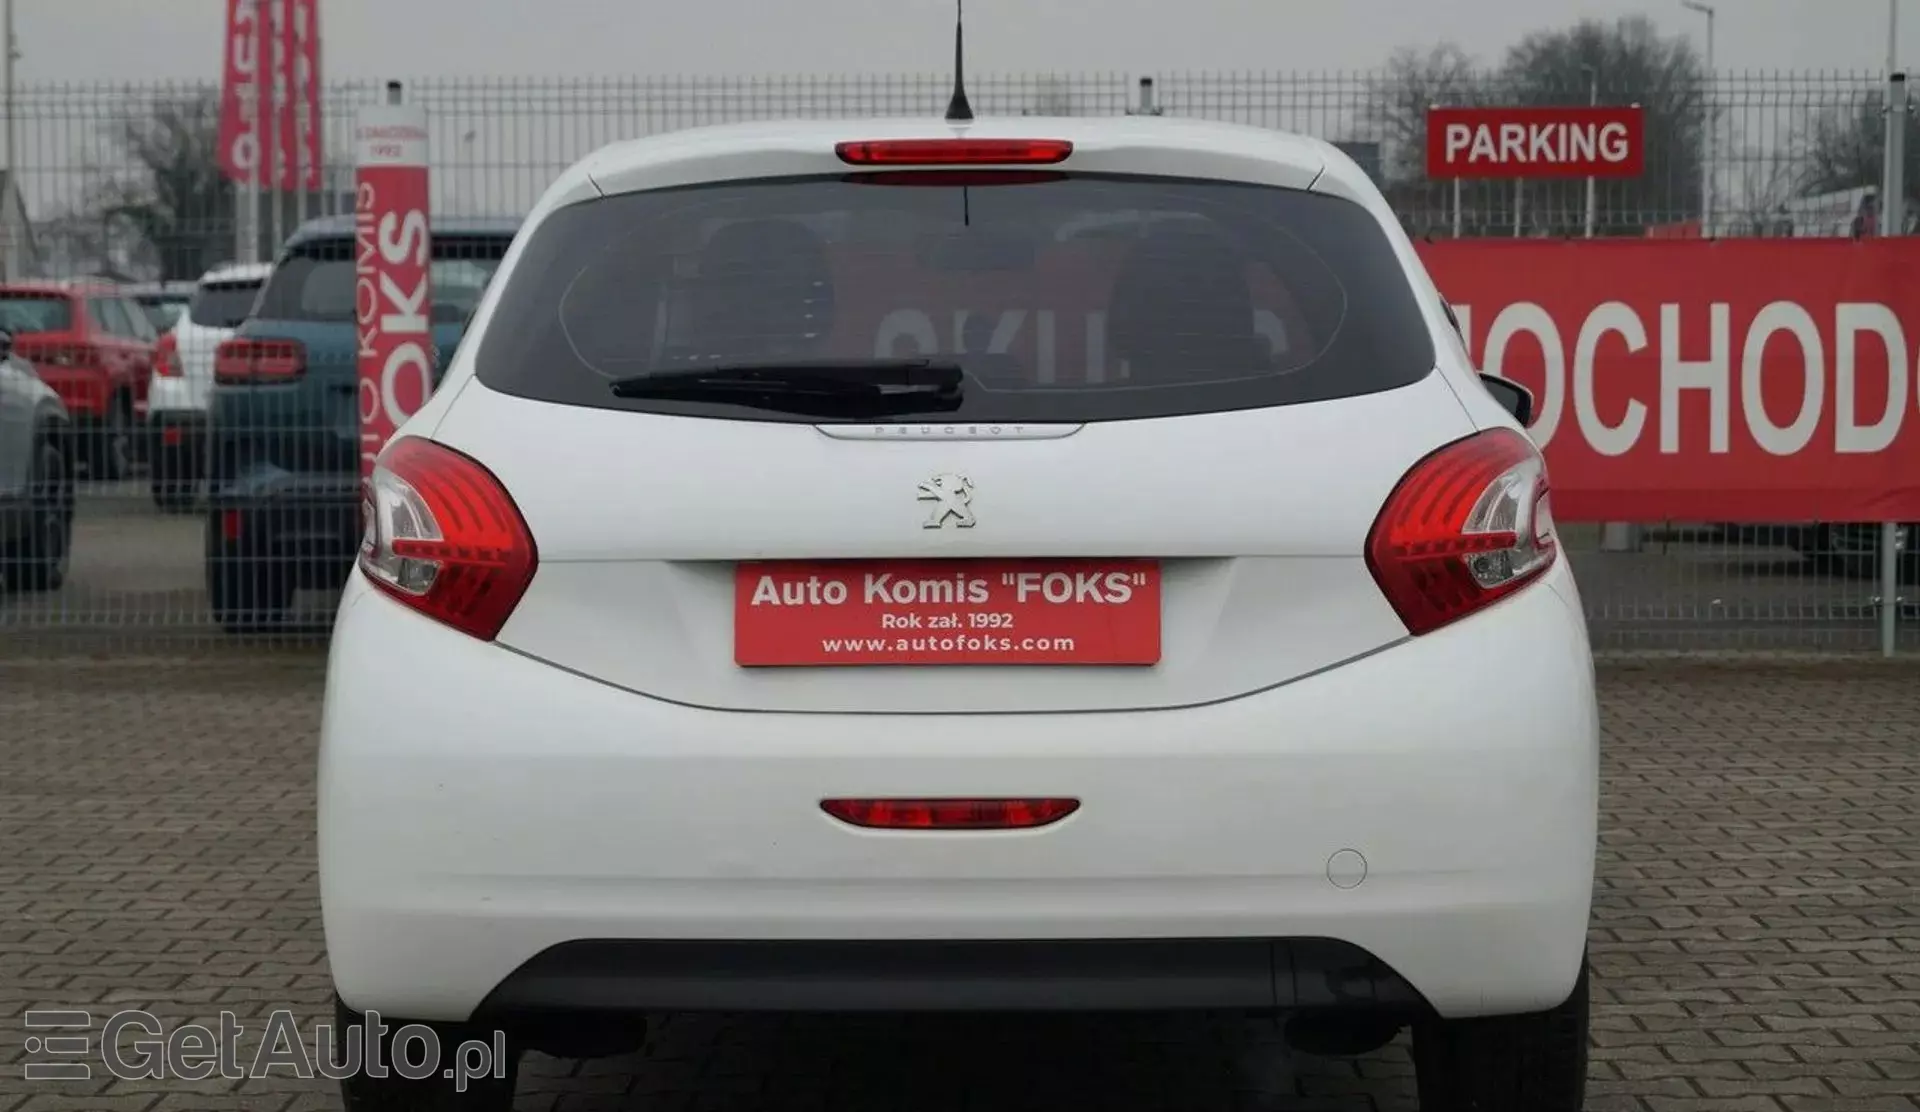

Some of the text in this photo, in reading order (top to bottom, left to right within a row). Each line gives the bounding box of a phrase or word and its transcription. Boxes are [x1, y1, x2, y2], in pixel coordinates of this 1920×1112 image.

[1446, 122, 1629, 163] PARKING
[356, 182, 378, 358] KOMIS
[378, 209, 430, 430] OKS
[1455, 301, 1920, 456] OCHOD
[873, 425, 1025, 436] PEUGEOT
[751, 572, 1147, 606] Auto Komis "FOKS"
[881, 612, 1014, 629] Rok zał. 1992
[822, 634, 1075, 652] www.autofoks.com
